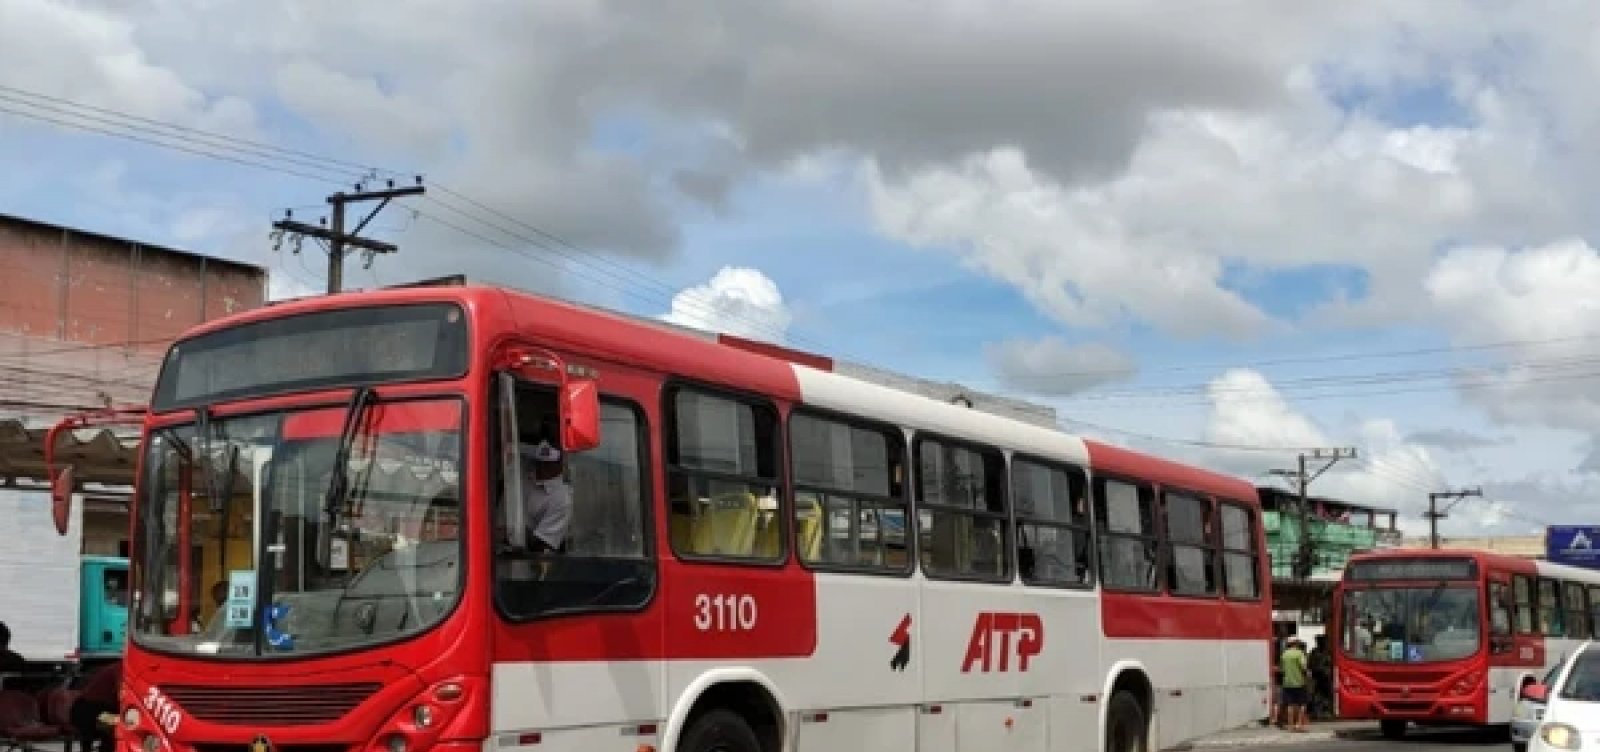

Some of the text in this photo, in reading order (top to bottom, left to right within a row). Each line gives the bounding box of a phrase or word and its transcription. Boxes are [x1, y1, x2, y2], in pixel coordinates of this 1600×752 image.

[694, 594, 757, 631] 3110
[961, 612, 1043, 673] ATP
[143, 686, 180, 734] 3110
